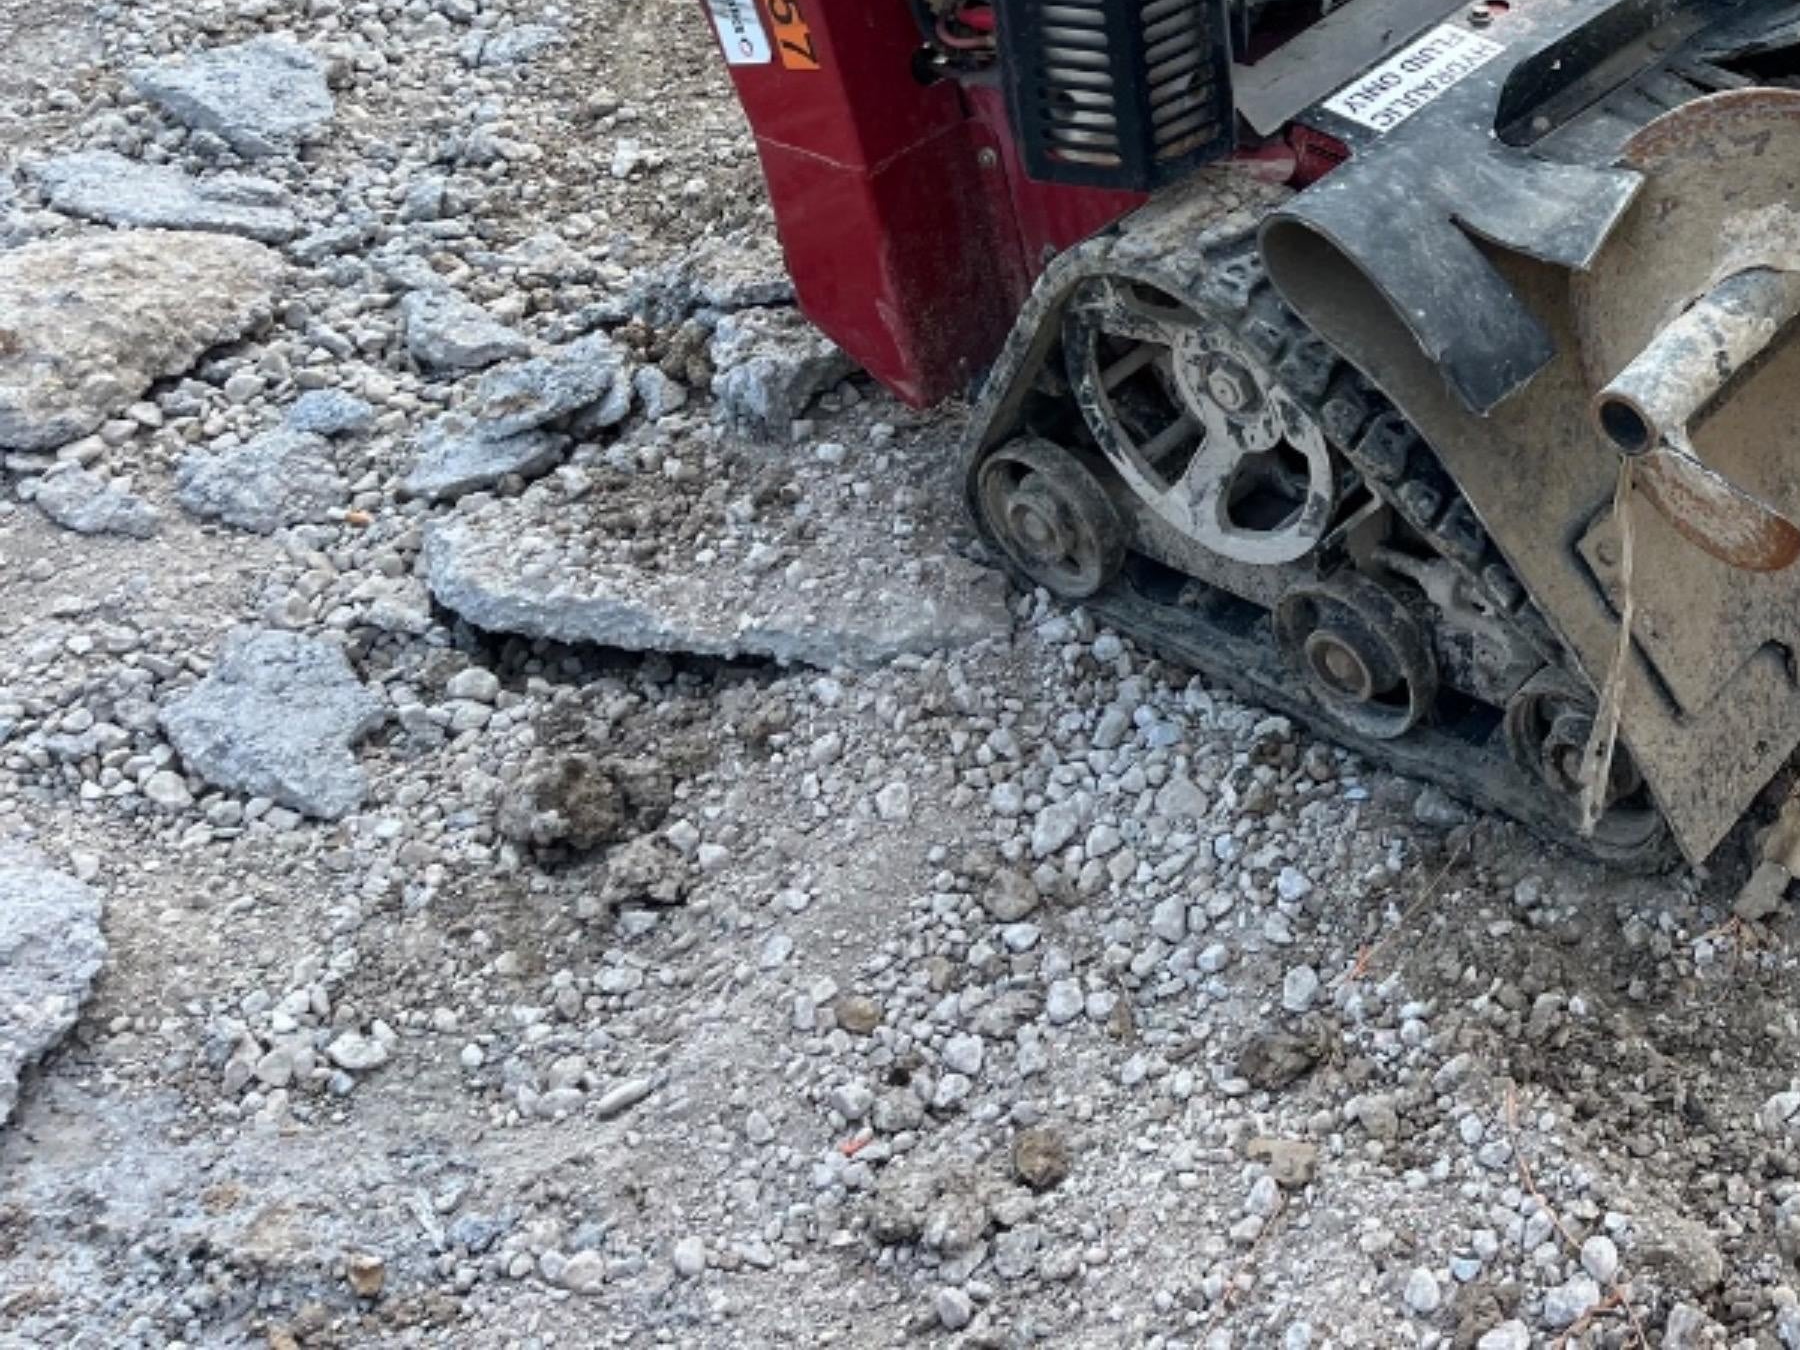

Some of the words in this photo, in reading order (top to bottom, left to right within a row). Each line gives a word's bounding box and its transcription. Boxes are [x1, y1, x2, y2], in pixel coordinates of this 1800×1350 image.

[1400, 31, 1466, 74] FLUID
[1343, 70, 1403, 115] ONLY
[1370, 43, 1498, 128] HYDRAULIC
